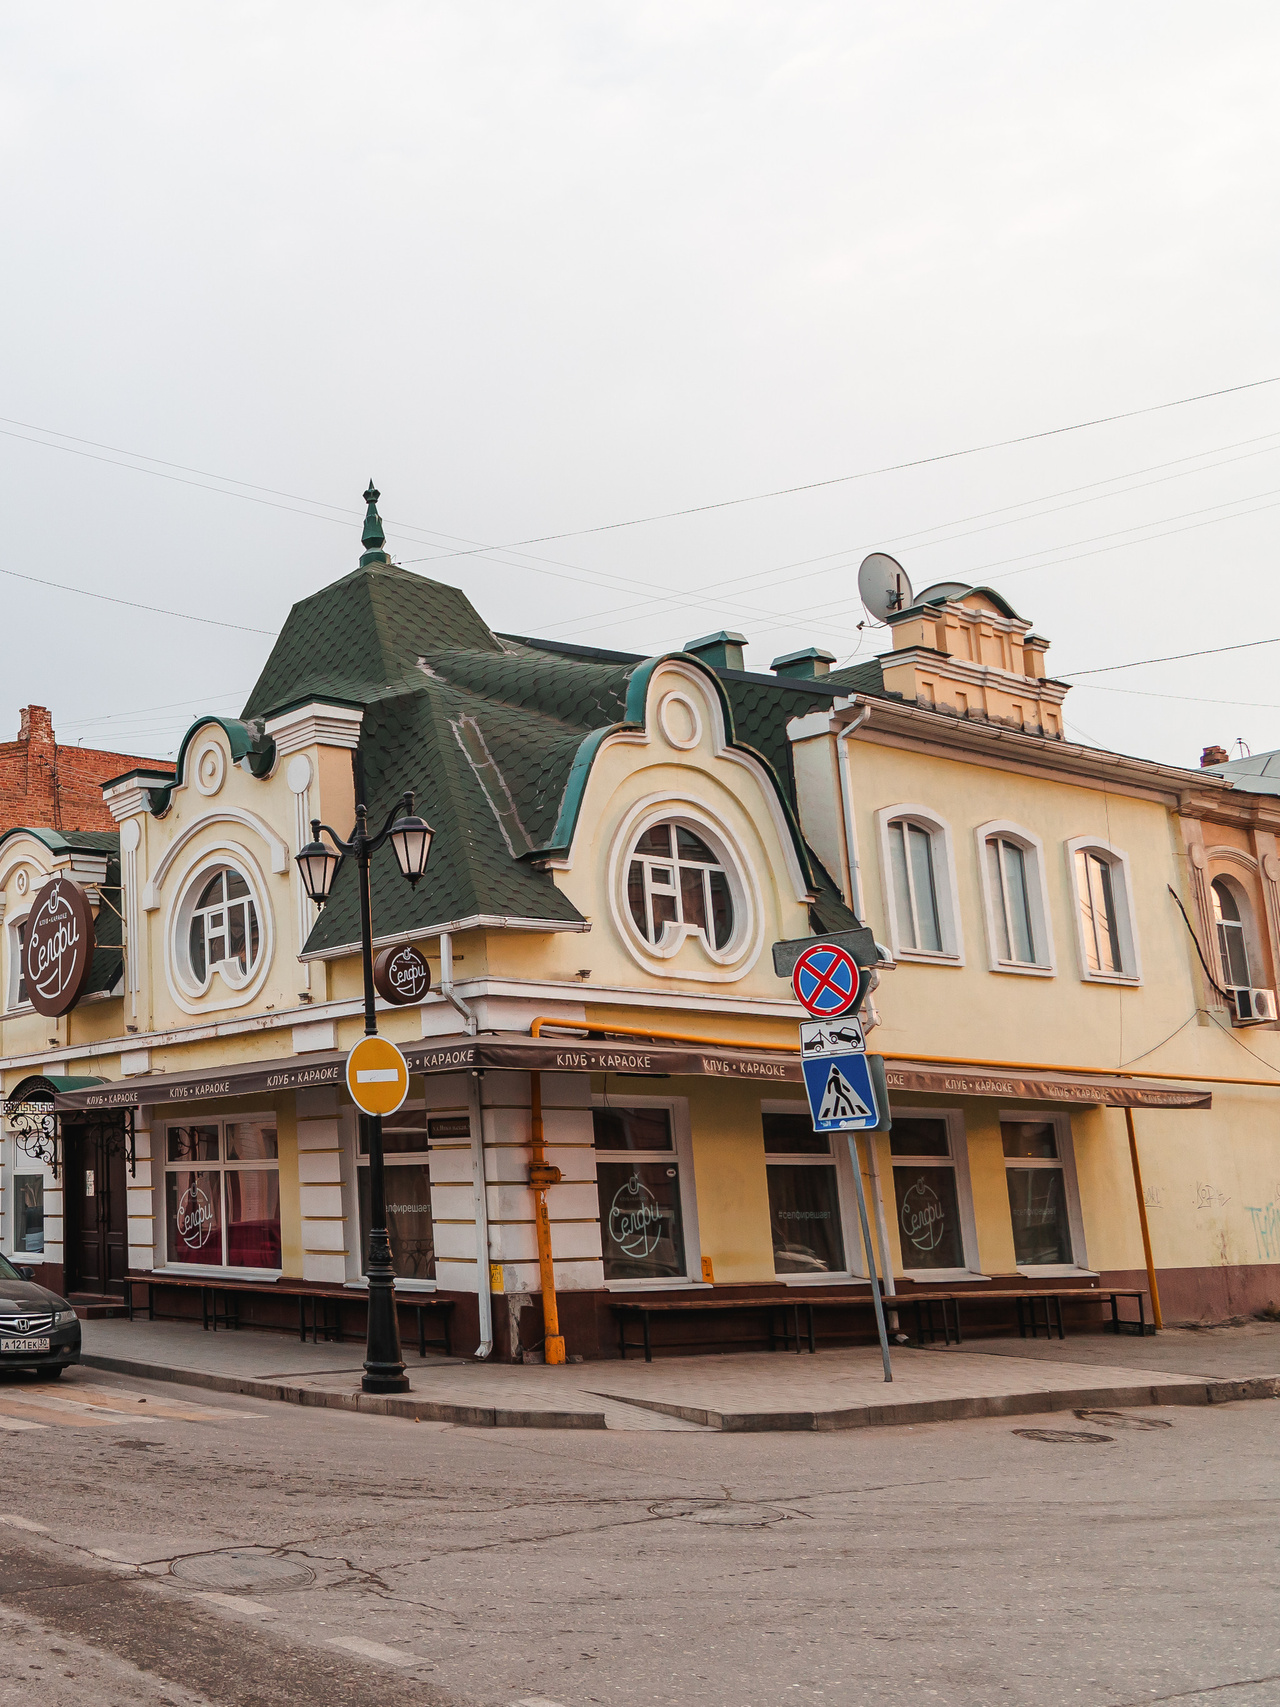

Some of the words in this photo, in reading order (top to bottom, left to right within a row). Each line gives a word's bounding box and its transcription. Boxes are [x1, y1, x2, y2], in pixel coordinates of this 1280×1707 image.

[28, 916, 80, 988] Селфи
[388, 964, 427, 989] Селфи
[423, 1050, 475, 1068] КАРАОКЕ
[556, 1054, 588, 1066] КЛУБ
[599, 1055, 651, 1068] КАРАОКЕ
[703, 1059, 730, 1072] КЛУБ
[739, 1062, 786, 1077] КАРАОКЕ
[266, 1074, 289, 1087] КЛУБ
[297, 1067, 339, 1083] КАРАОКЕ
[945, 1079, 967, 1090] КЛУБ
[975, 1081, 1014, 1093] КАРАОКЕ
[86, 1096, 103, 1105] КЛУБ
[108, 1092, 138, 1103] КАРАОКЕ
[169, 1087, 189, 1098] КЛУБ
[195, 1082, 230, 1096] КАРАОКЕ
[1049, 1086, 1069, 1098] КЛУБ
[1076, 1089, 1110, 1101] КАРАОКЕ
[176, 1203, 213, 1240] Селфи
[608, 1201, 663, 1247] Селфи
[901, 1202, 945, 1240] Селфи
